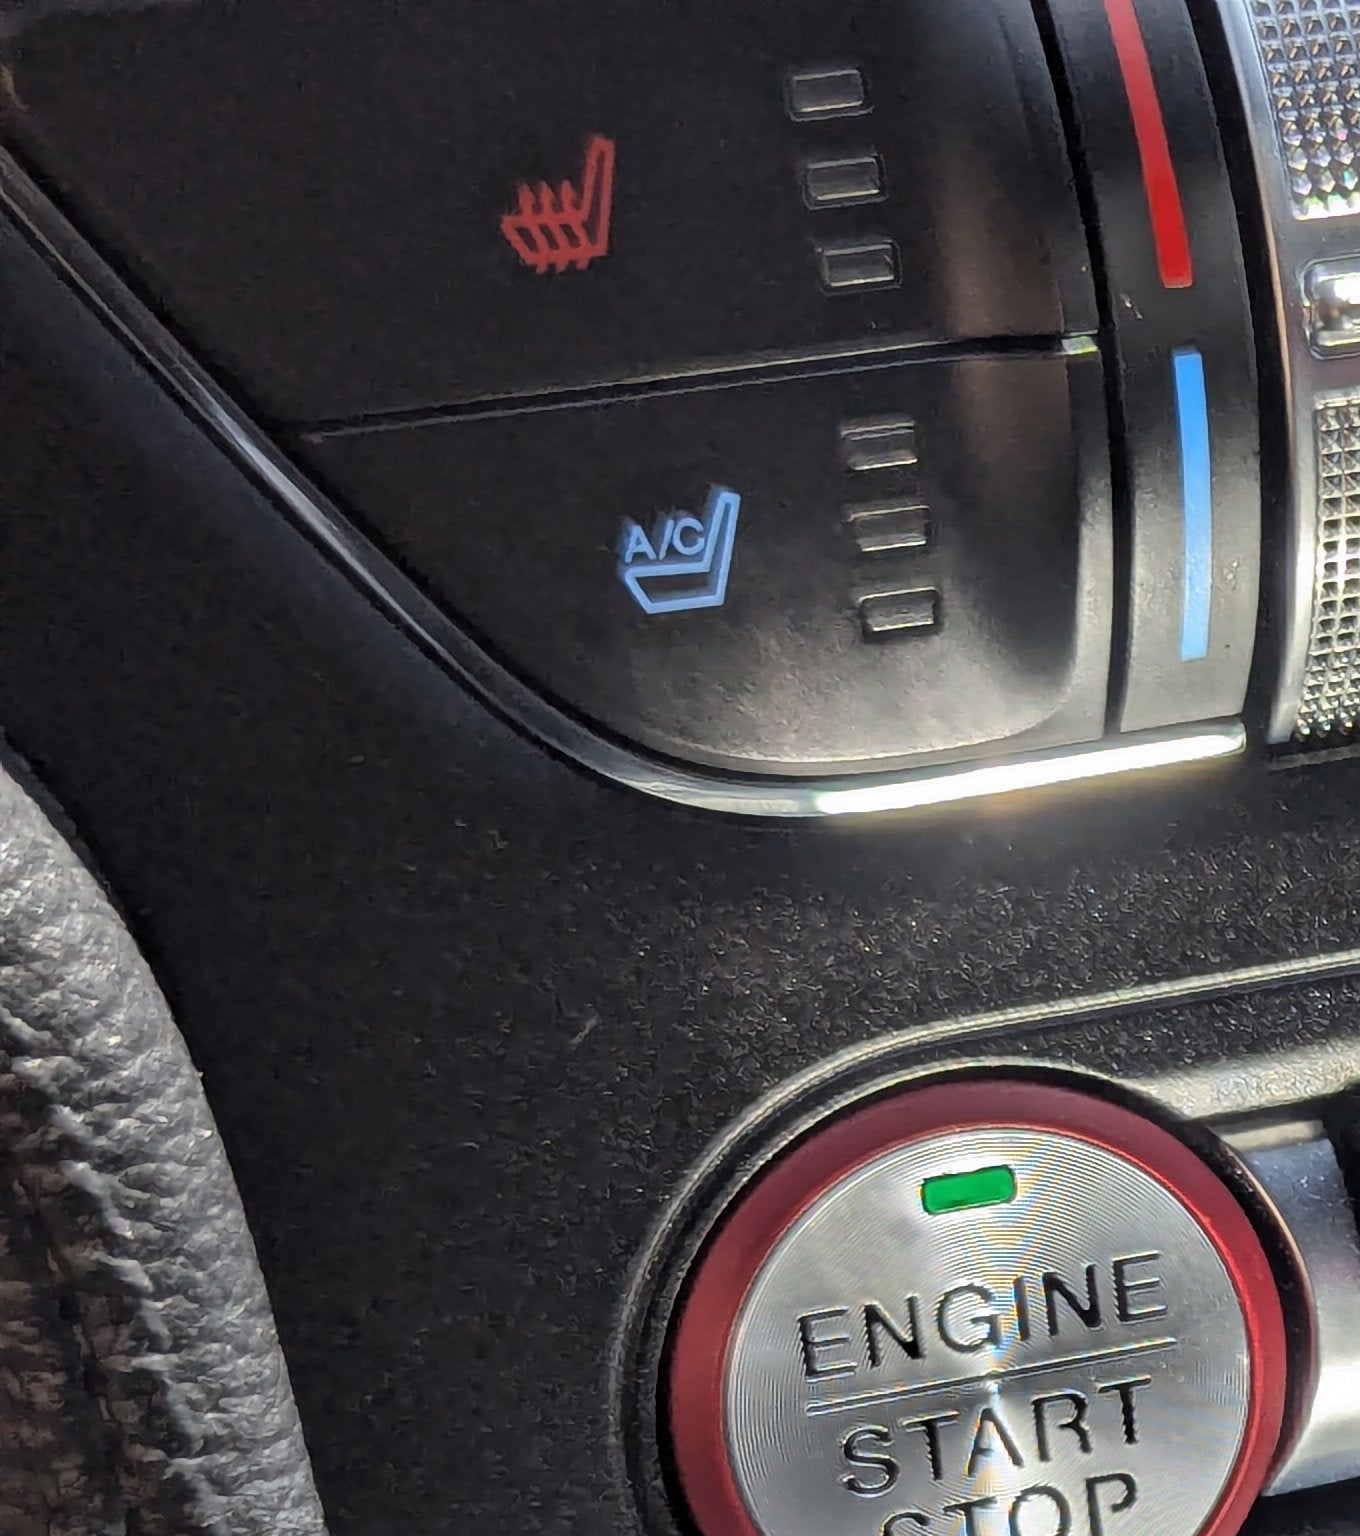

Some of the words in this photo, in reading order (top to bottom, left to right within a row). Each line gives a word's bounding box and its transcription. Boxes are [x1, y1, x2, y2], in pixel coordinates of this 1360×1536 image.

[624, 516, 705, 564] A/C
[797, 1251, 1168, 1382] ENGINE
[837, 1374, 1152, 1499] START
